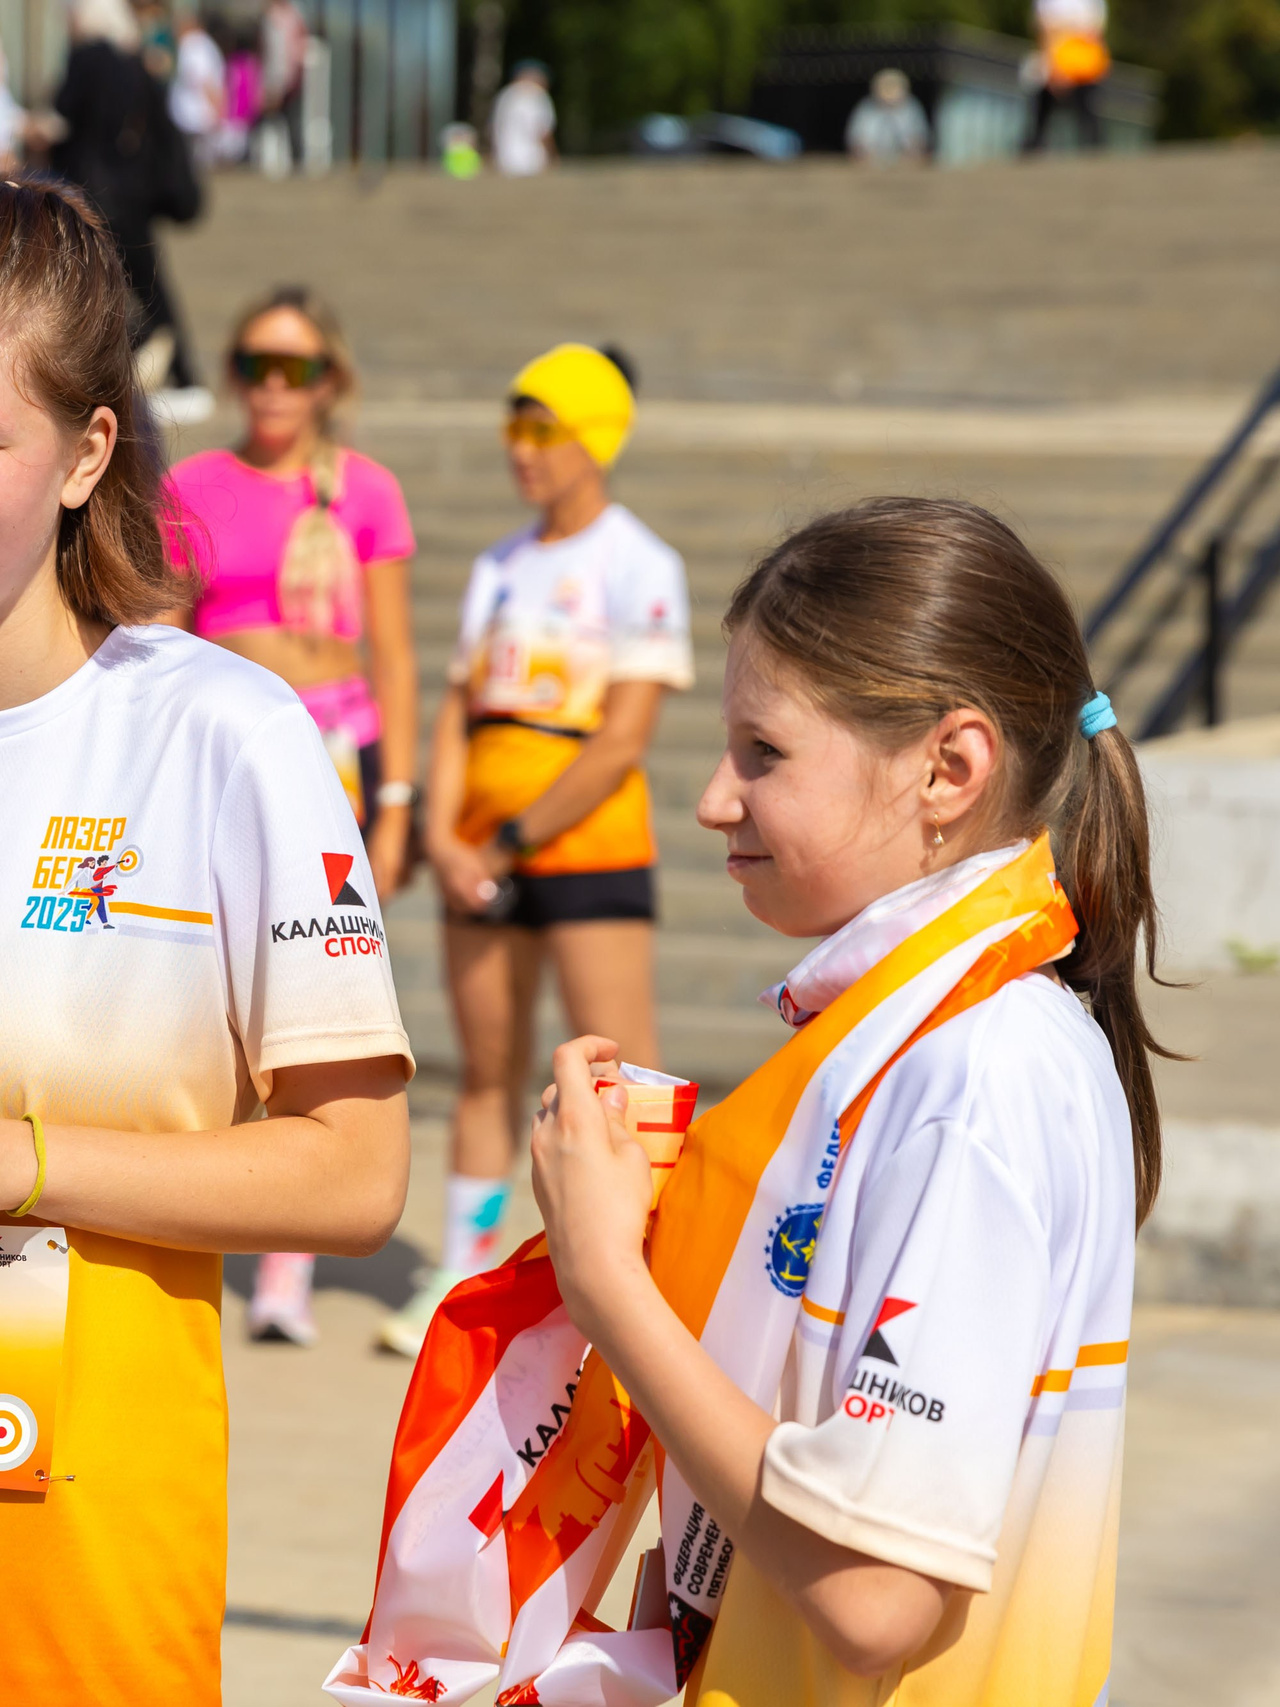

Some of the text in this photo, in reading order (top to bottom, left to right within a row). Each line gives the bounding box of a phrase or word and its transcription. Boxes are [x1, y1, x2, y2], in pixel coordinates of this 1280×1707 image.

[40, 816, 127, 851] ЛАЗЕР
[20, 896, 90, 932] 2025
[324, 936, 383, 958] СПОРТ
[673, 1501, 705, 1586] ФЕДЕРАЦИЯ
